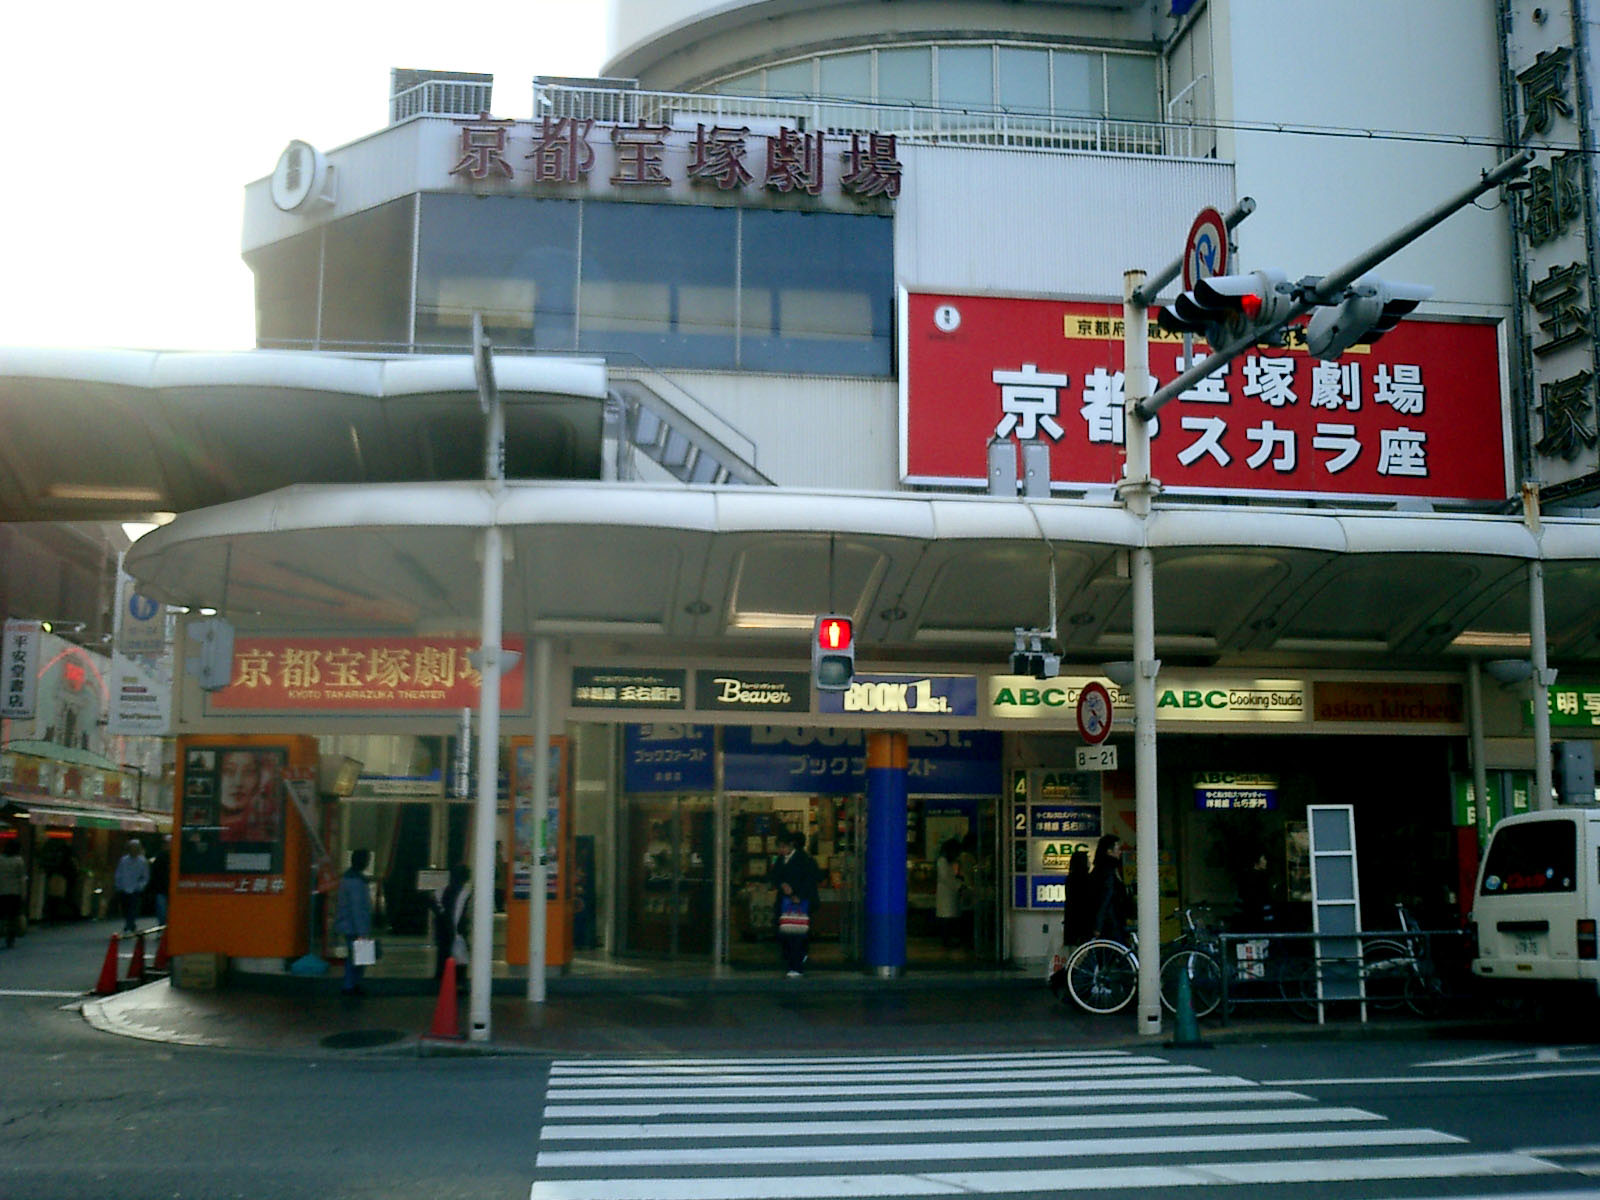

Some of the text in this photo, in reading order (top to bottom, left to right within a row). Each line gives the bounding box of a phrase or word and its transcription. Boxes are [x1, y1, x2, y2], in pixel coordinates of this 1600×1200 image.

[449, 111, 903, 199] 京都宝塚劇場
[1175, 352, 1426, 414] 宝塚劇場
[992, 364, 1160, 444] 京都
[1177, 415, 1429, 478] スカラ座
[288, 690, 446, 700] KYOTO TAKARAZUKA THEATER
[713, 677, 791, 704] Beaver
[844, 679, 953, 712] BOOK 1st.
[993, 687, 1066, 707] ABC
[1157, 690, 1303, 709] ABC Cooking Studio
[1320, 703, 1374, 719] asian
[1530, 692, 1600, 715] 明写
[1015, 778, 1026, 795] 4
[1015, 813, 1026, 830] 2
